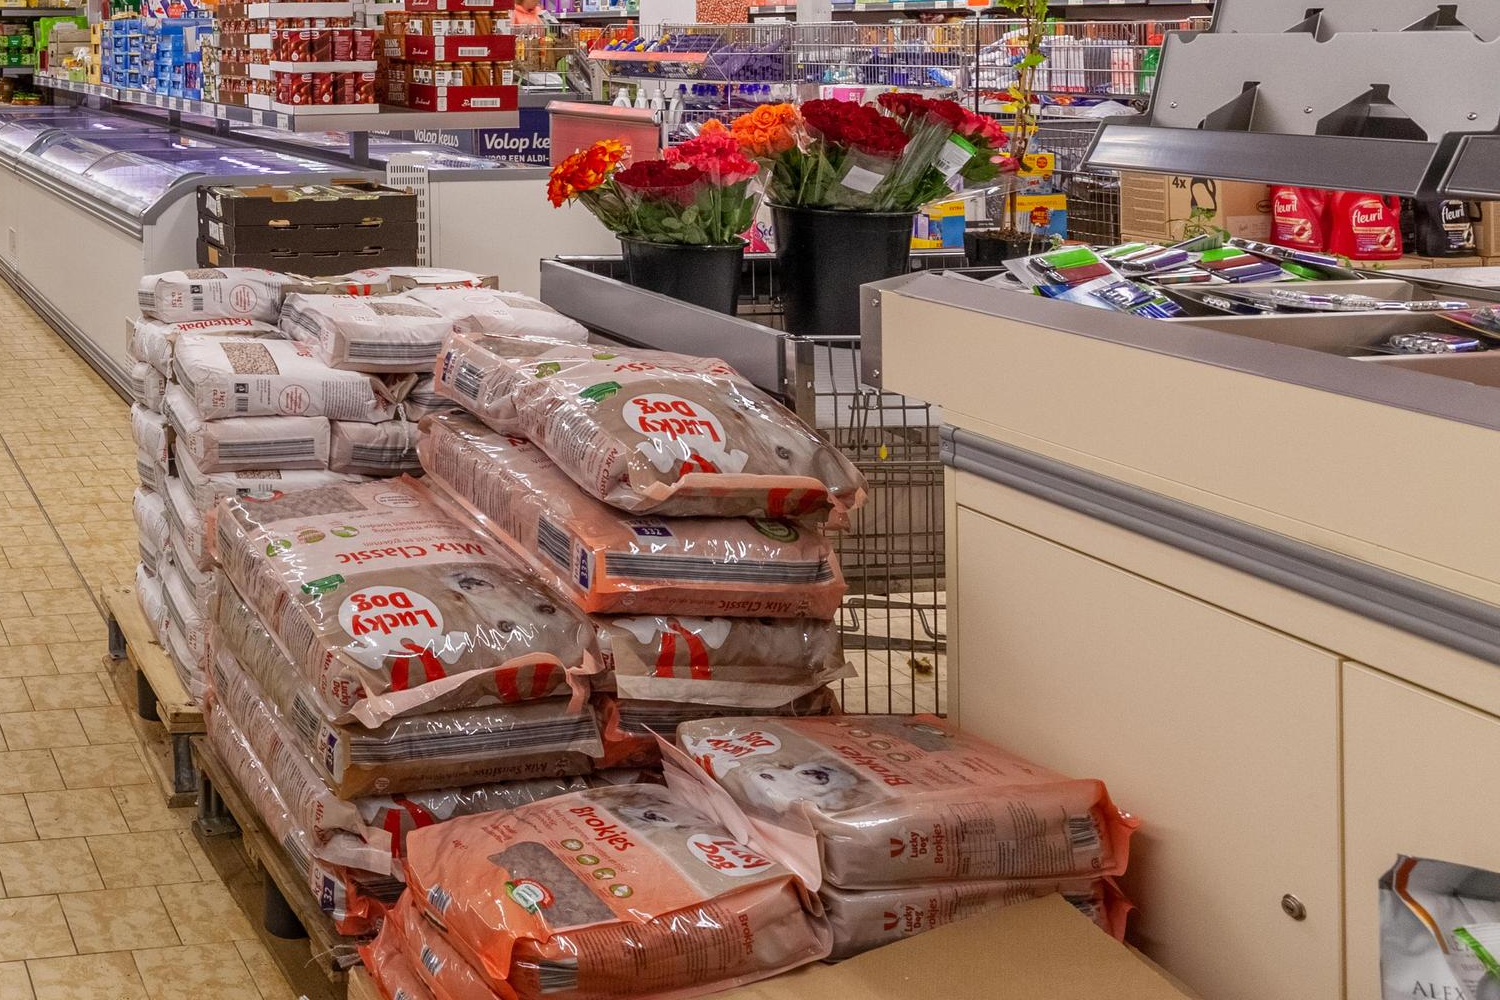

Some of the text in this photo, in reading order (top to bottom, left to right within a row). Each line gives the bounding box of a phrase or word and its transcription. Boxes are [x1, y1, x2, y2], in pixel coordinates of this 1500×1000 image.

[414, 129, 459, 148] Volop keus
[484, 132, 530, 153] Volop
[526, 153, 550, 164] ALDI-
[1172, 176, 1187, 190] 4x
[1274, 198, 1298, 214] fleuril
[1352, 206, 1383, 226] fleuril
[1442, 204, 1465, 222] fleuril
[177, 317, 253, 333] Kattenbak
[632, 398, 697, 418] Dog
[638, 416, 721, 442] Lucky
[605, 447, 619, 468] Mix
[335, 542, 488, 565] Mix Classic
[350, 591, 414, 613] Dog
[716, 600, 762, 612] Classic
[765, 601, 791, 612] Mix
[351, 608, 438, 636] Lucky
[324, 651, 333, 667] Mix
[332, 680, 340, 700] Dog
[340, 681, 350, 707] Lucky
[706, 738, 757, 758] Lucky
[739, 730, 775, 747] Dog
[531, 762, 548, 773] Mix
[832, 745, 913, 787] Brokjes
[569, 805, 636, 852] Brokjes
[910, 831, 921, 858] Lucky
[920, 833, 928, 854] Dog
[934, 823, 947, 864] Brokjes
[694, 841, 737, 871] Dog
[904, 905, 915, 933] Lucky
[914, 910, 924, 929] Dog
